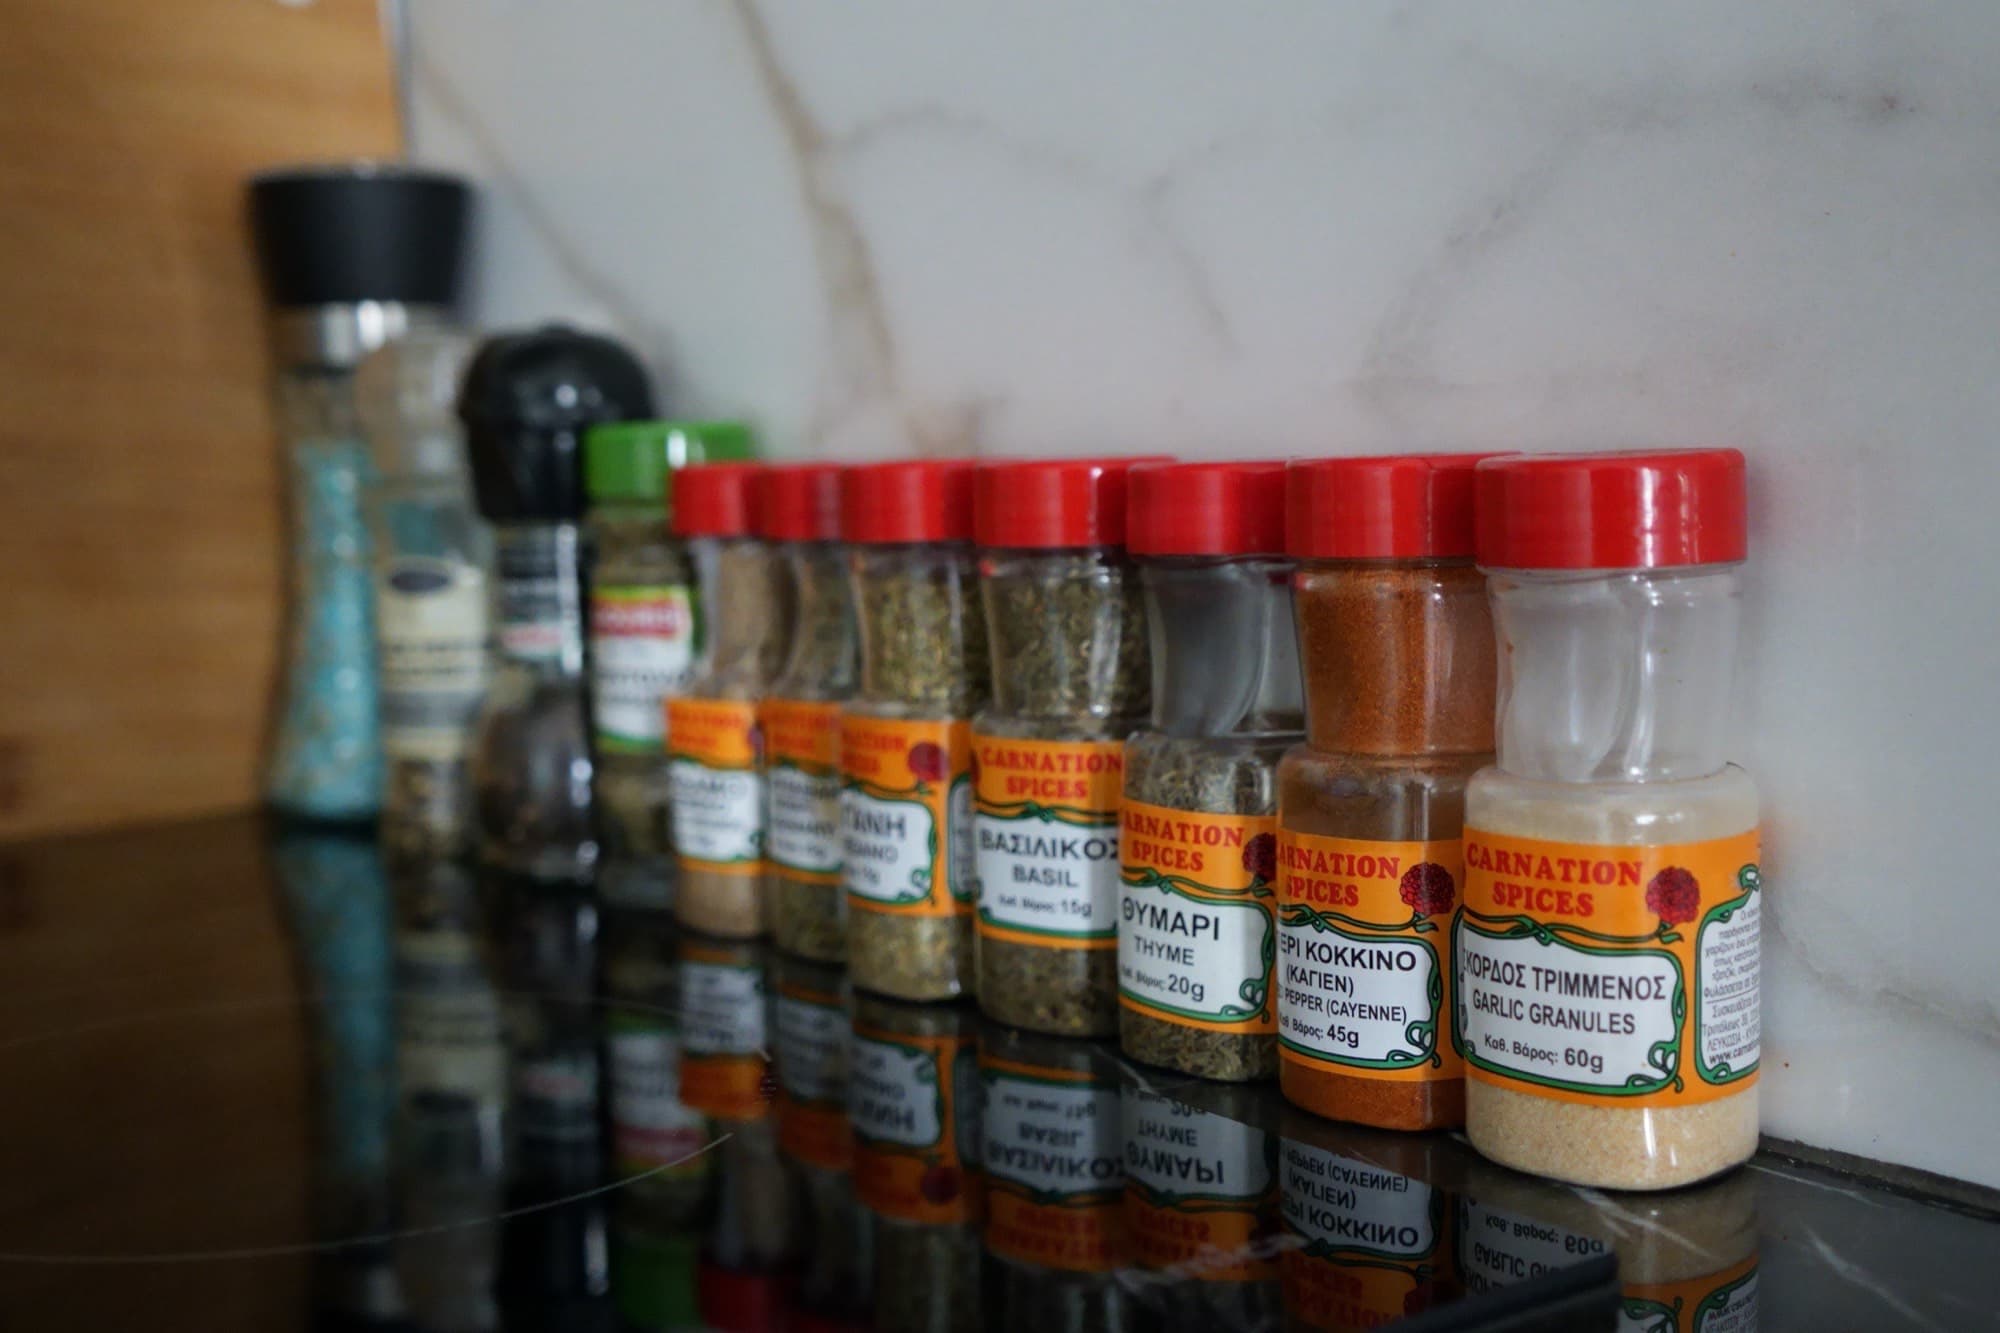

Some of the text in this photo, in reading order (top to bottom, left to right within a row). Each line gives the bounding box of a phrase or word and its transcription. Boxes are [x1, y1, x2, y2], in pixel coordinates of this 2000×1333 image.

[982, 748, 1122, 773] CARNATION
[1005, 775, 1089, 798] SPICES
[1123, 811, 1245, 848] ARNATION
[1131, 840, 1204, 872] SPICES
[1279, 843, 1400, 879] ARNATION
[1467, 843, 1643, 886] CARNATION
[1013, 864, 1078, 888] BASIL
[1492, 881, 1594, 917] SPICES
[1122, 897, 1220, 940] ΘΥΜΑΡΙ
[1134, 936, 1194, 966] THYME
[1279, 931, 1417, 972] ΕΡΙ ΚΟΚΚΙΝΟ
[1168, 974, 1205, 1002] 20g
[1286, 963, 1354, 998] (ΚΑΓΙΕΝ)
[1531, 966, 1666, 1001] ΤΡΙΜΜΕΝΟΣ
[1285, 987, 1323, 1013] PEPPER
[1326, 1000, 1407, 1025] (CAYENNE)
[1473, 989, 1636, 1034] GARLIC GRANULES
[1327, 1025, 1359, 1048] 45g
[1513, 1042, 1558, 1064] Βάρος:
[1564, 1047, 1604, 1073] 60g
